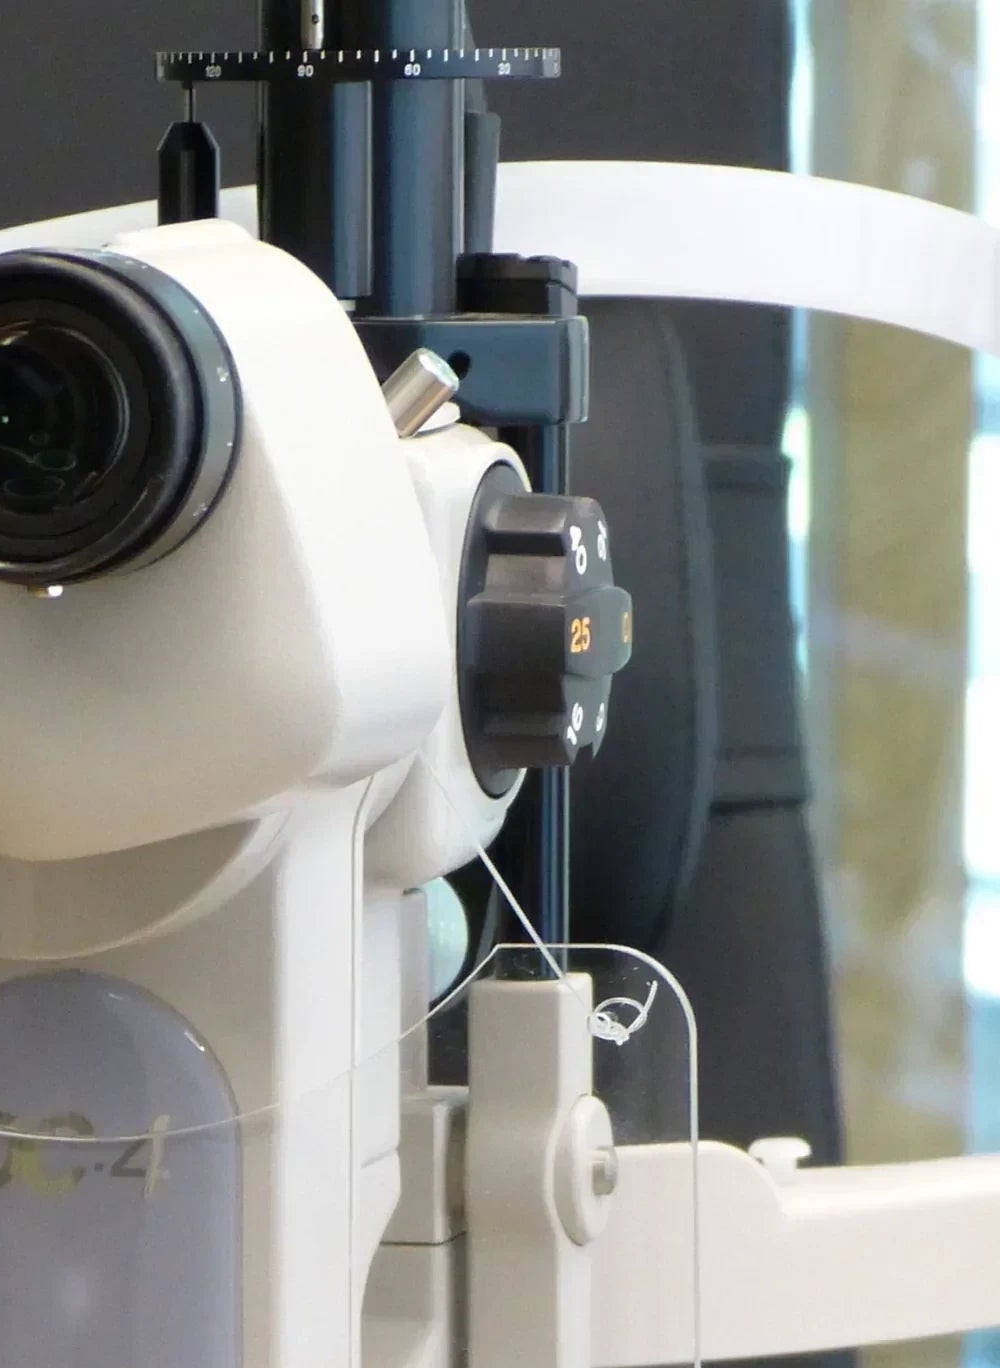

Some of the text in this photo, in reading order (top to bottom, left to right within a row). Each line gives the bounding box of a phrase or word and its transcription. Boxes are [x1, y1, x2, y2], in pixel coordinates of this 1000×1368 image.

[297, 64, 314, 77] 90
[404, 63, 421, 76] 60
[570, 617, 591, 653] 25
